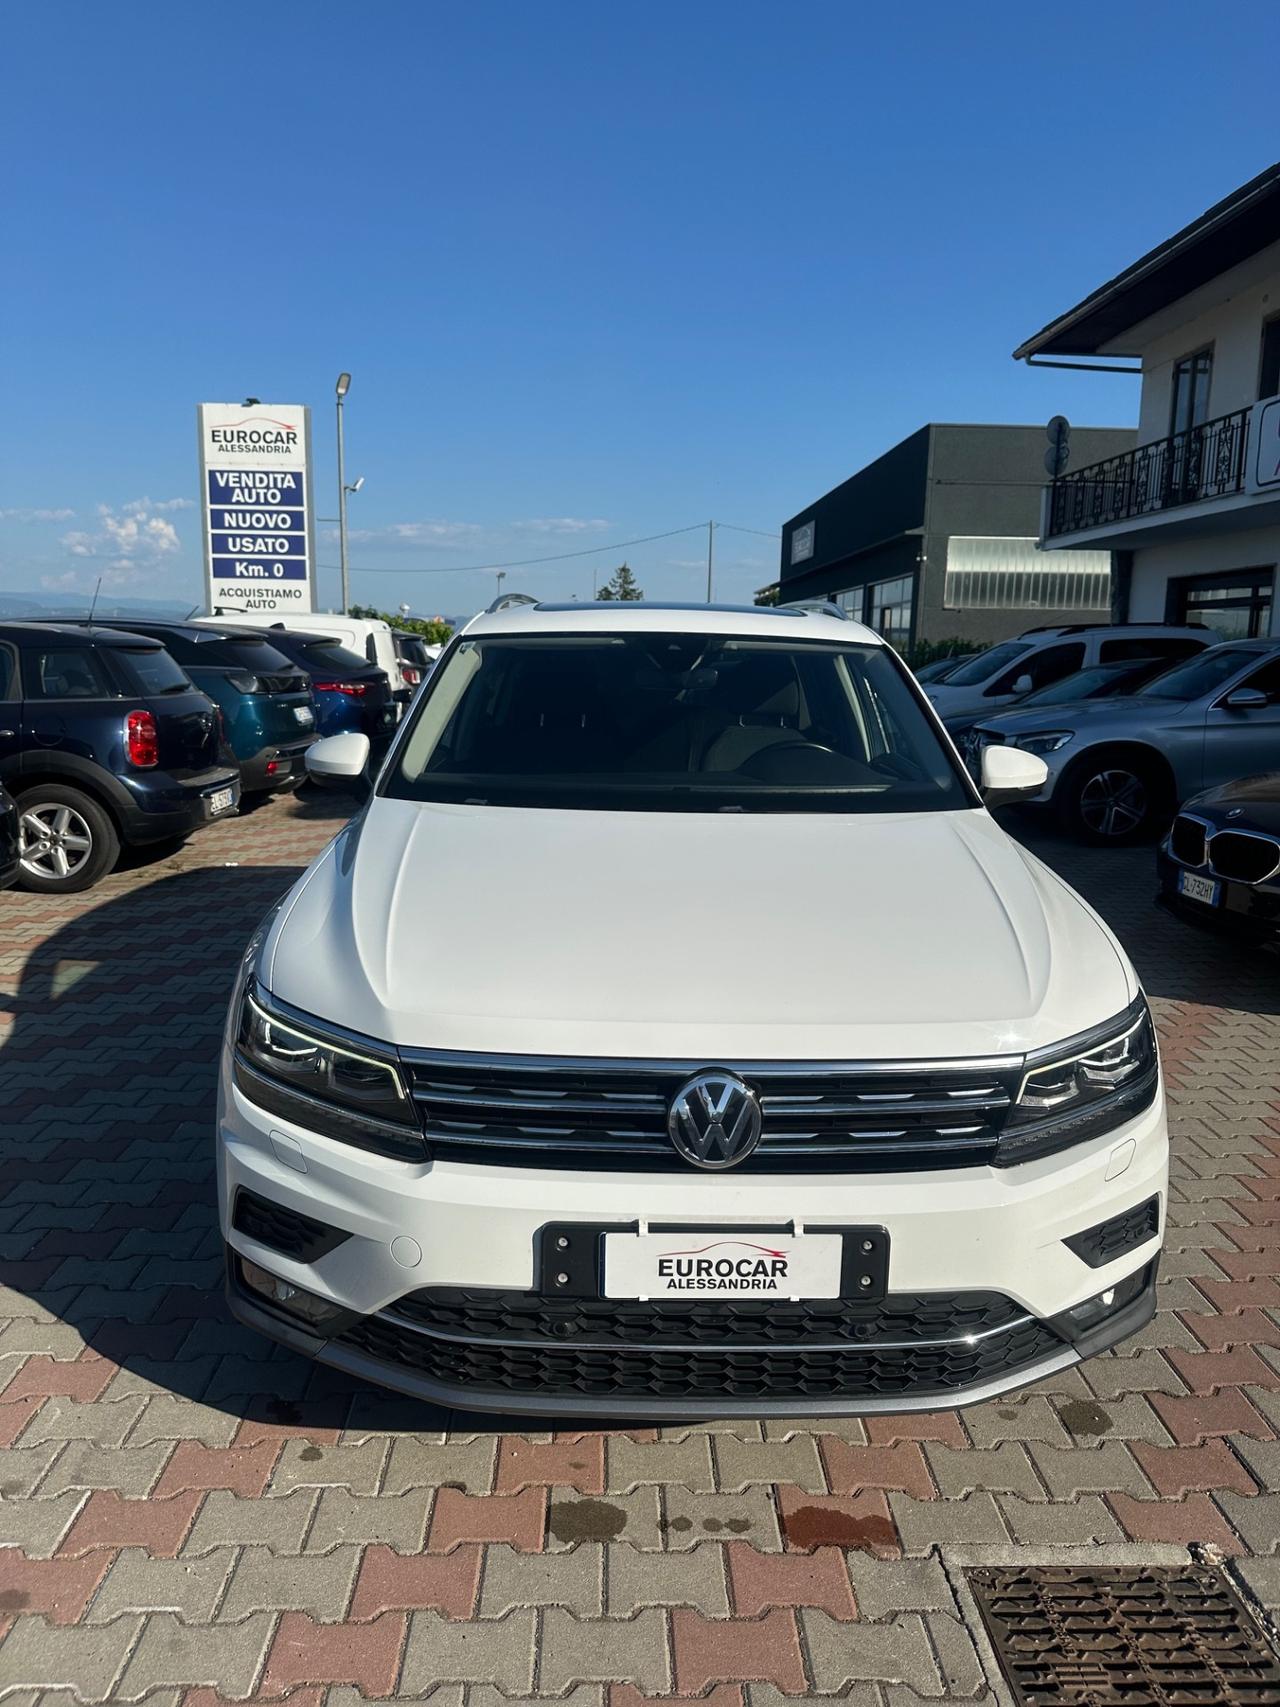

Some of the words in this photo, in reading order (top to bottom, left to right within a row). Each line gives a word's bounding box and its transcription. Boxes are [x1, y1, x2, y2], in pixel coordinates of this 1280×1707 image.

[211, 430, 297, 445] EUROCAR
[218, 444, 291, 454] ALESSANDRIA
[215, 472, 296, 489] VENDITA
[231, 488, 281, 504] AUTO
[224, 512, 292, 529] NUOVO
[227, 537, 289, 553] USATO
[235, 561, 269, 577] Km.
[273, 563, 284, 577] 0
[219, 588, 302, 599] ACQUISTIAMO
[246, 599, 277, 609] AUTO
[658, 1258, 788, 1278] EUROCAR
[667, 1278, 778, 1290] ALESSANDRIA
